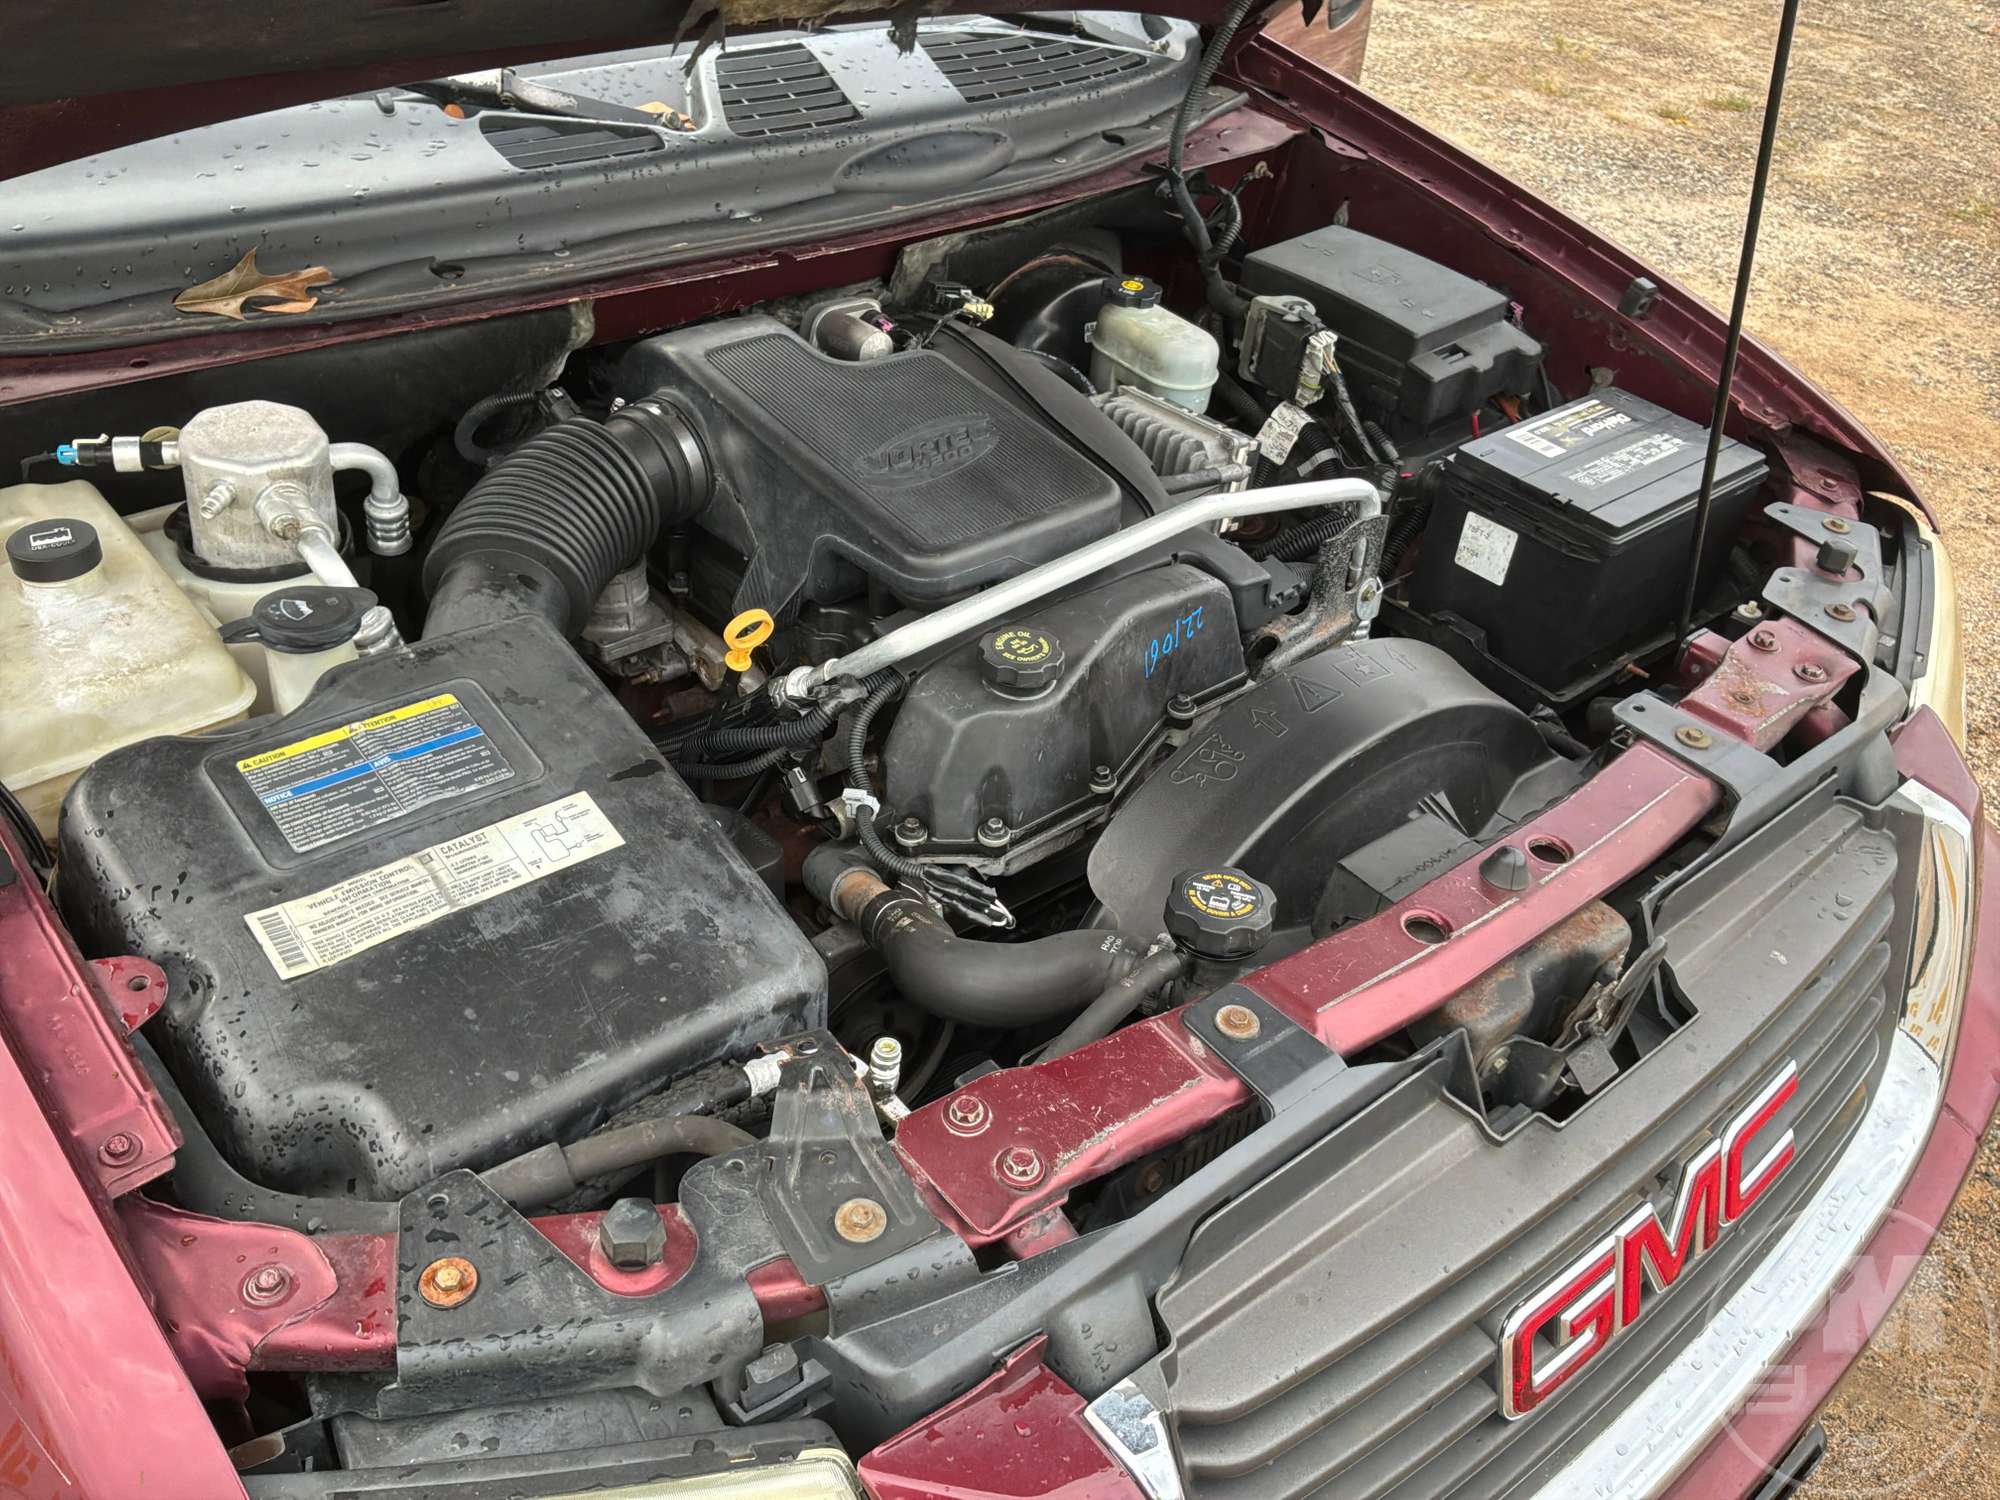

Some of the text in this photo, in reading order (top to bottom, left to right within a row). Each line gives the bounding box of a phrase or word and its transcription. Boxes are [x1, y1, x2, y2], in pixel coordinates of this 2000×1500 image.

[1017, 630, 1032, 639] OIL
[252, 751, 286, 767] CAUTION
[373, 756, 392, 768] AVIS
[264, 790, 293, 804] NOTICE
[439, 831, 488, 854] CATALYST
[306, 863, 414, 910] VEHICLE EMISSION CONTROL
[338, 879, 392, 903] INFORMATION
[1101, 935, 1115, 951] RAD
[1499, 1060, 1799, 1420] GMC
